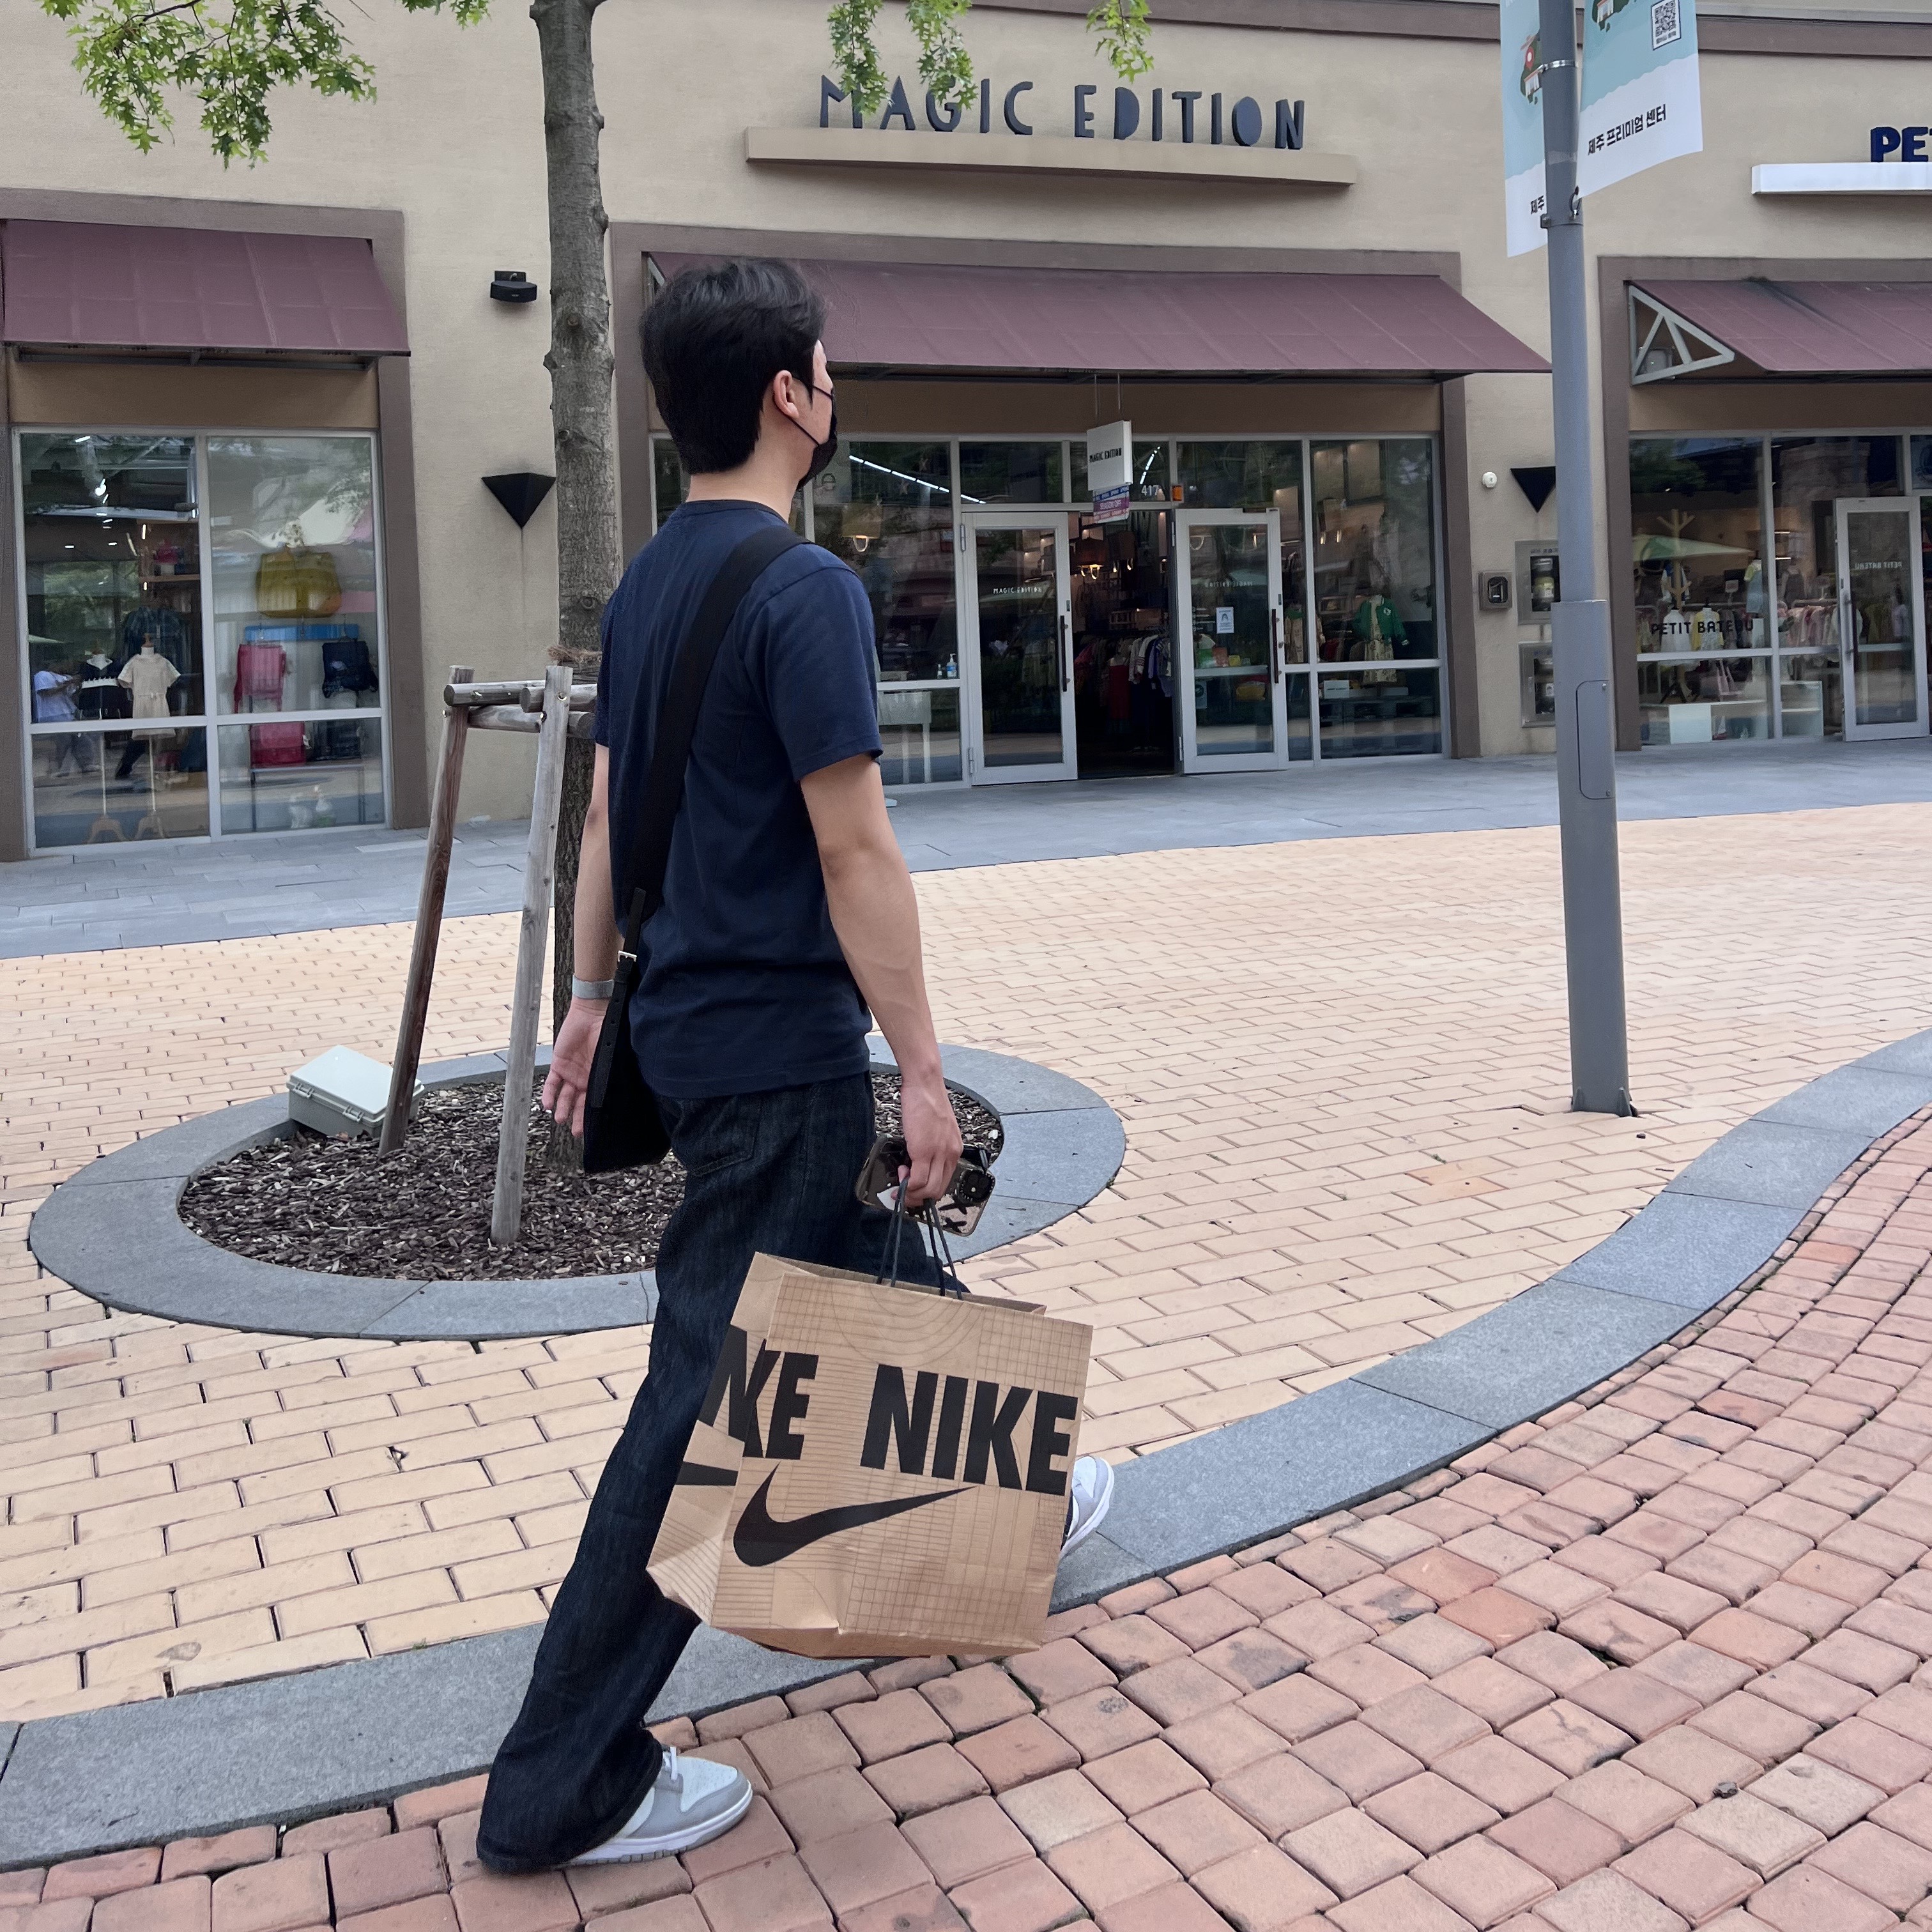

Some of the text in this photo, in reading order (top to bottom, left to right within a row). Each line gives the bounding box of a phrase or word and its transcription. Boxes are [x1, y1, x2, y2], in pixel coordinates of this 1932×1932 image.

[820, 74, 1305, 150] MAGIC EDITION
[1588, 104, 1666, 155] 제주 프리미엄 센터
[1871, 126, 1932, 162] PE
[1089, 448, 1122, 463] MAGIC EDITION
[1141, 484, 1159, 496] 417
[1651, 622, 1691, 634] PETIT
[860, 1363, 1078, 1496] NIKE
